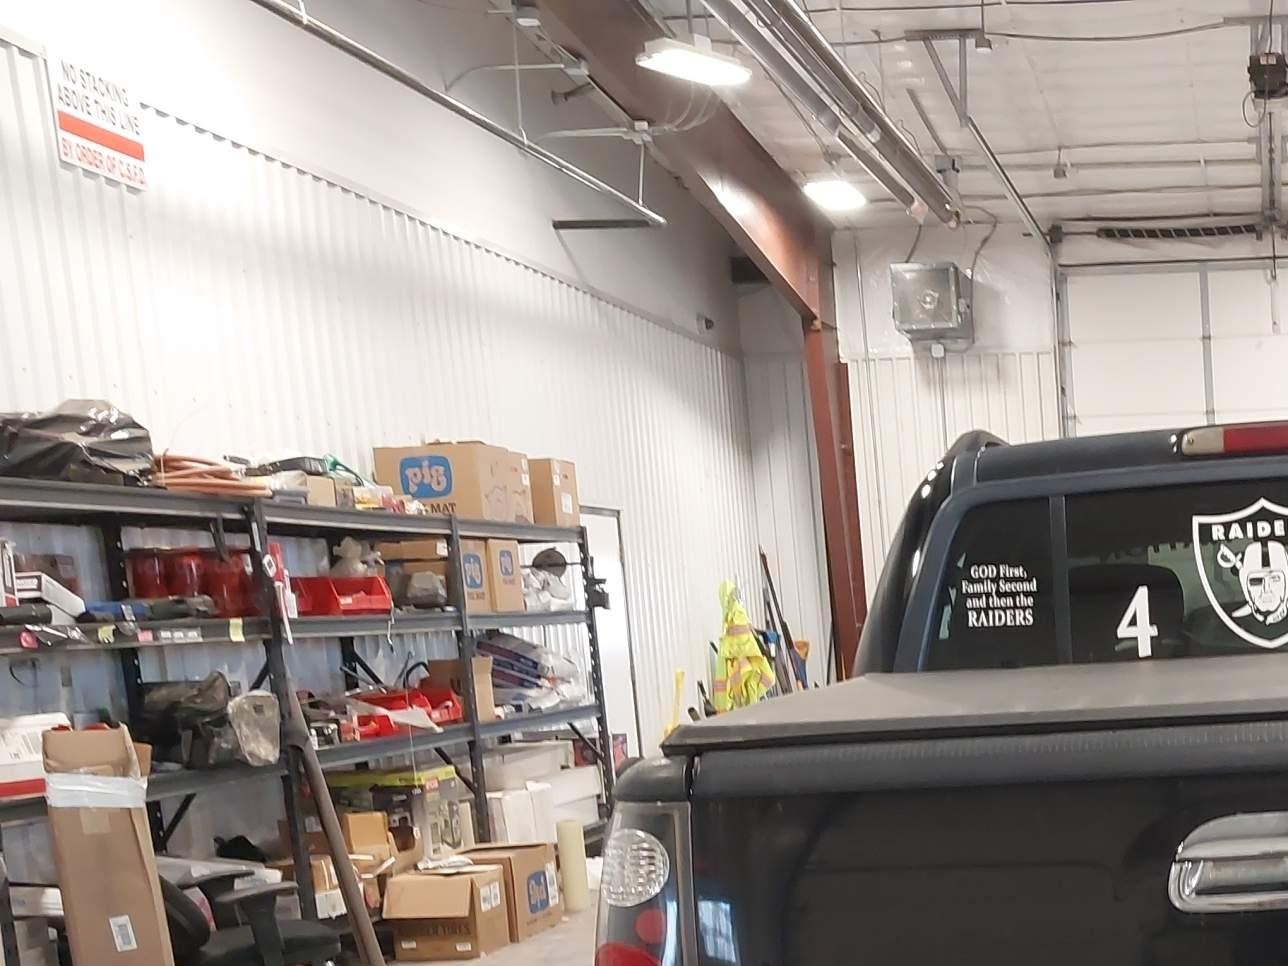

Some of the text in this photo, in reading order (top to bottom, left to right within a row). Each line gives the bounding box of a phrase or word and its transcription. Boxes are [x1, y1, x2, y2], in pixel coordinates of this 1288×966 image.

[61, 59, 128, 107] NO STACKING
[57, 83, 140, 136] ABOVE THIS LINE
[405, 460, 447, 494] pig
[431, 502, 457, 513] MAT
[970, 564, 1028, 579] GOD First,
[961, 577, 1037, 595] Family Second
[966, 593, 1034, 609] and then the
[967, 608, 1034, 628] RAIDERS
[1116, 585, 1158, 658] 4
